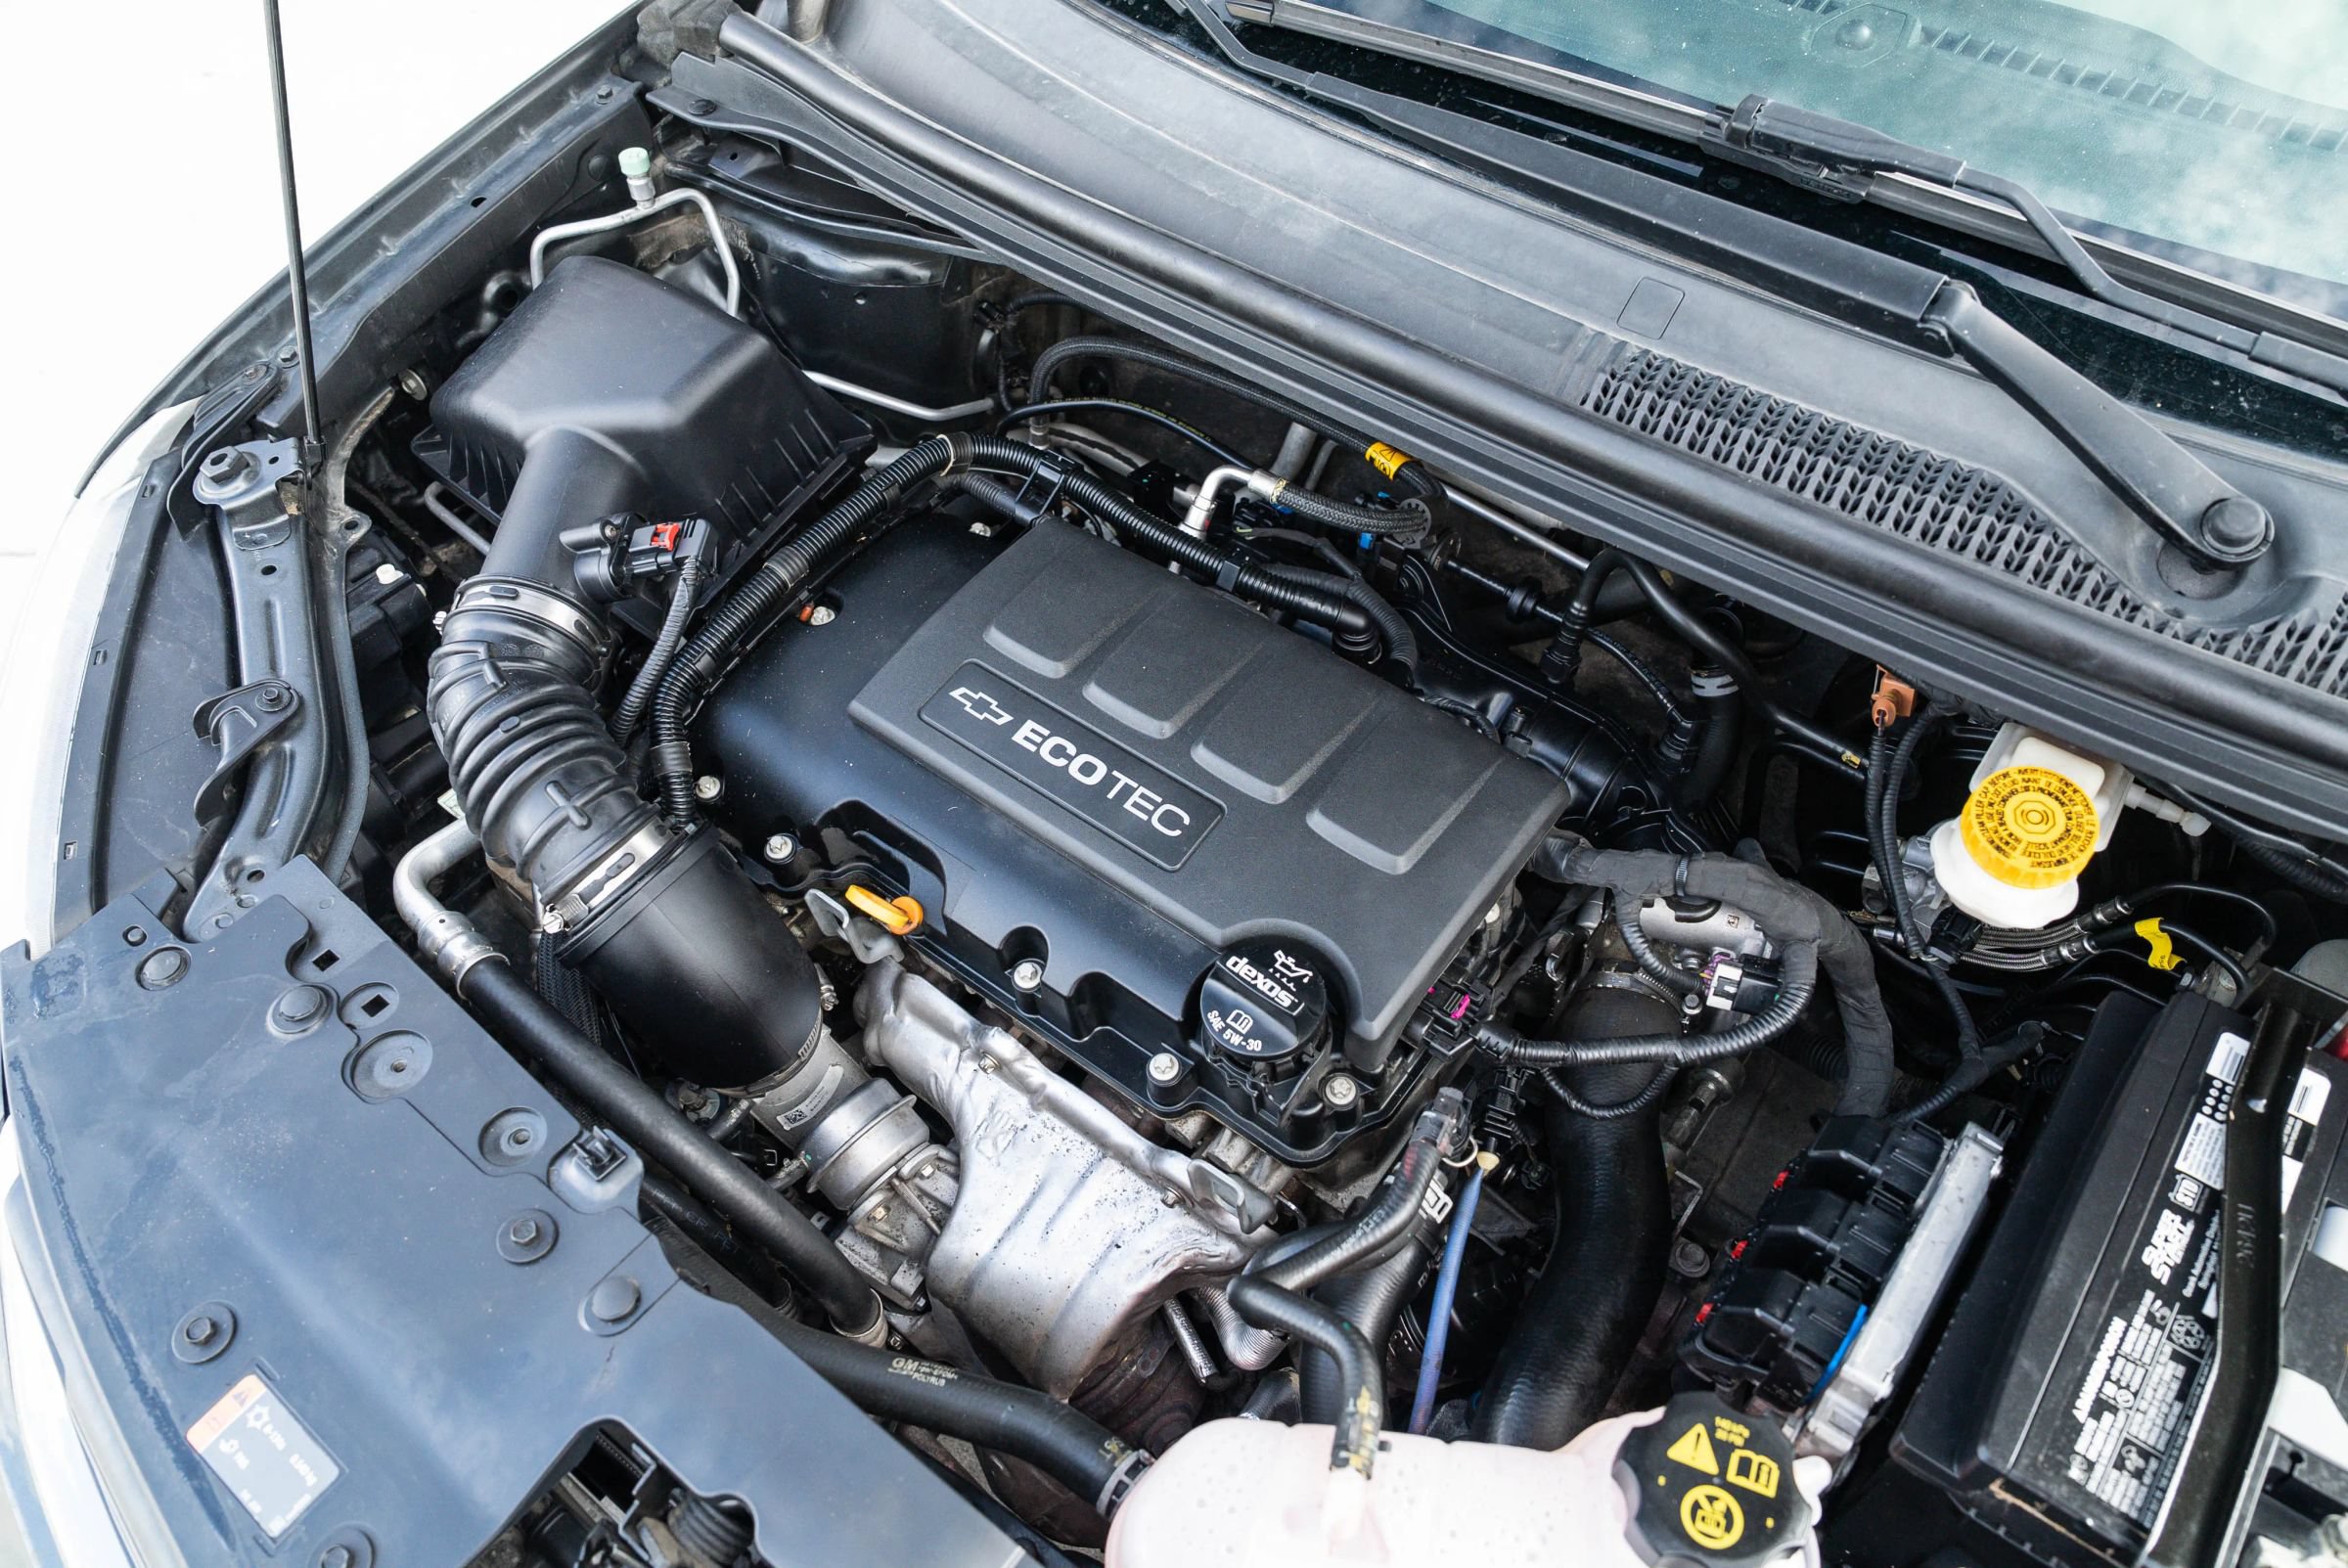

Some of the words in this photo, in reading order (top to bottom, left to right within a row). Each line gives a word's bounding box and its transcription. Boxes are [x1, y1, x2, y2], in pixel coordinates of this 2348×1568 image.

[1012, 719, 1190, 837] ECOTEC
[1226, 956, 1293, 1008] dexos
[1207, 1009, 1226, 1032] SAE
[1222, 1028, 1263, 1053] 5W-30
[891, 1357, 920, 1371] GM
